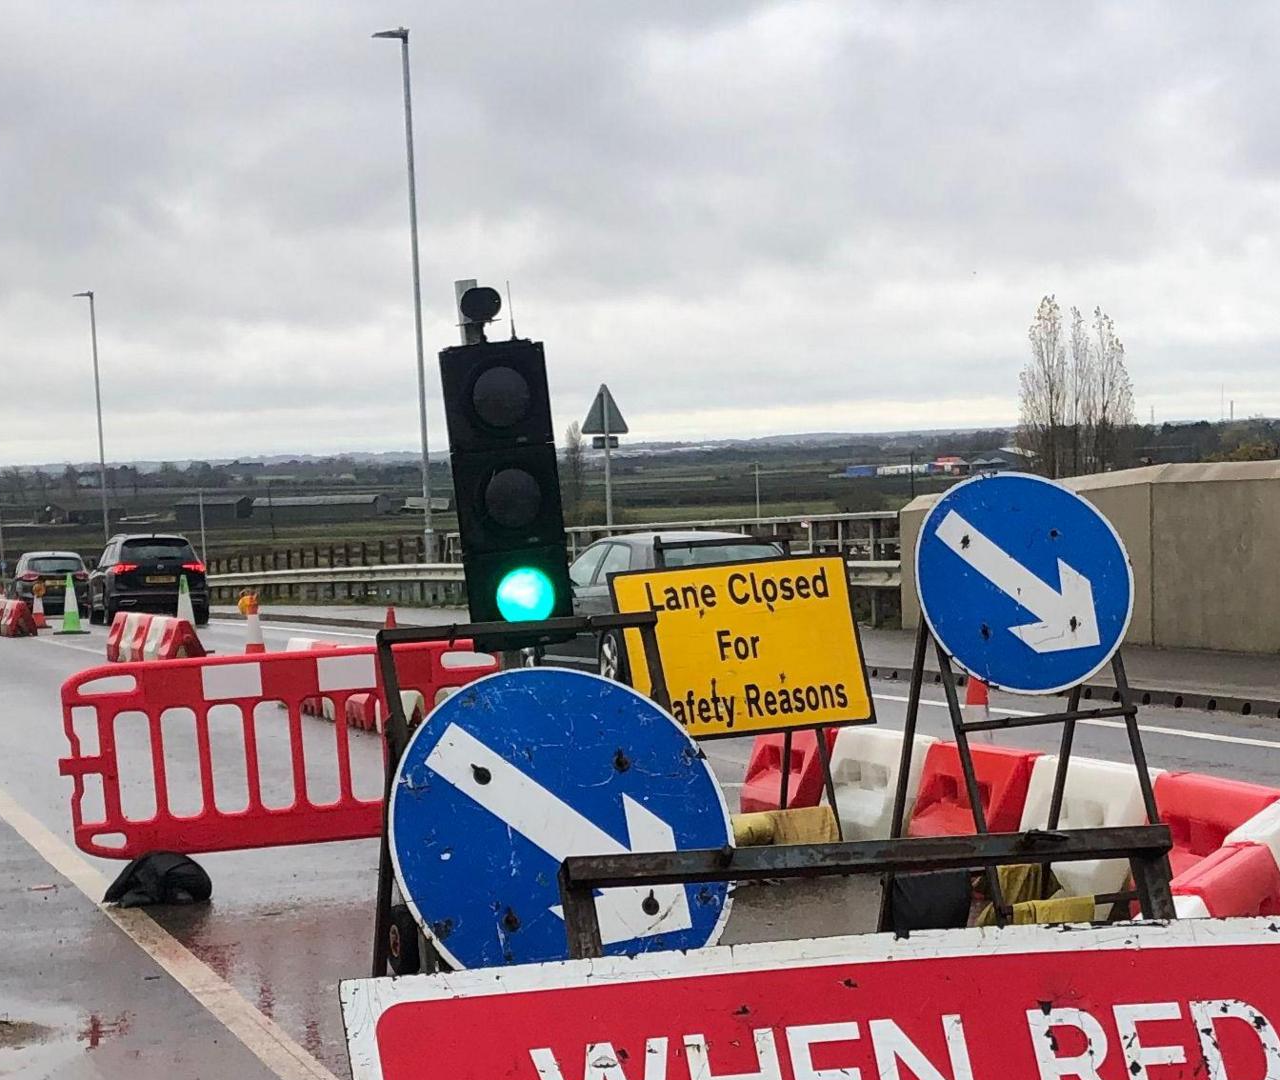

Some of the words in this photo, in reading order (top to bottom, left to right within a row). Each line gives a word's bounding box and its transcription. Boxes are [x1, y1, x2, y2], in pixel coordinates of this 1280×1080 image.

[645, 582, 717, 611] Lane
[728, 567, 829, 604] Closed
[717, 630, 759, 661] For
[671, 678, 735, 727] afety
[744, 683, 848, 717] Reasons
